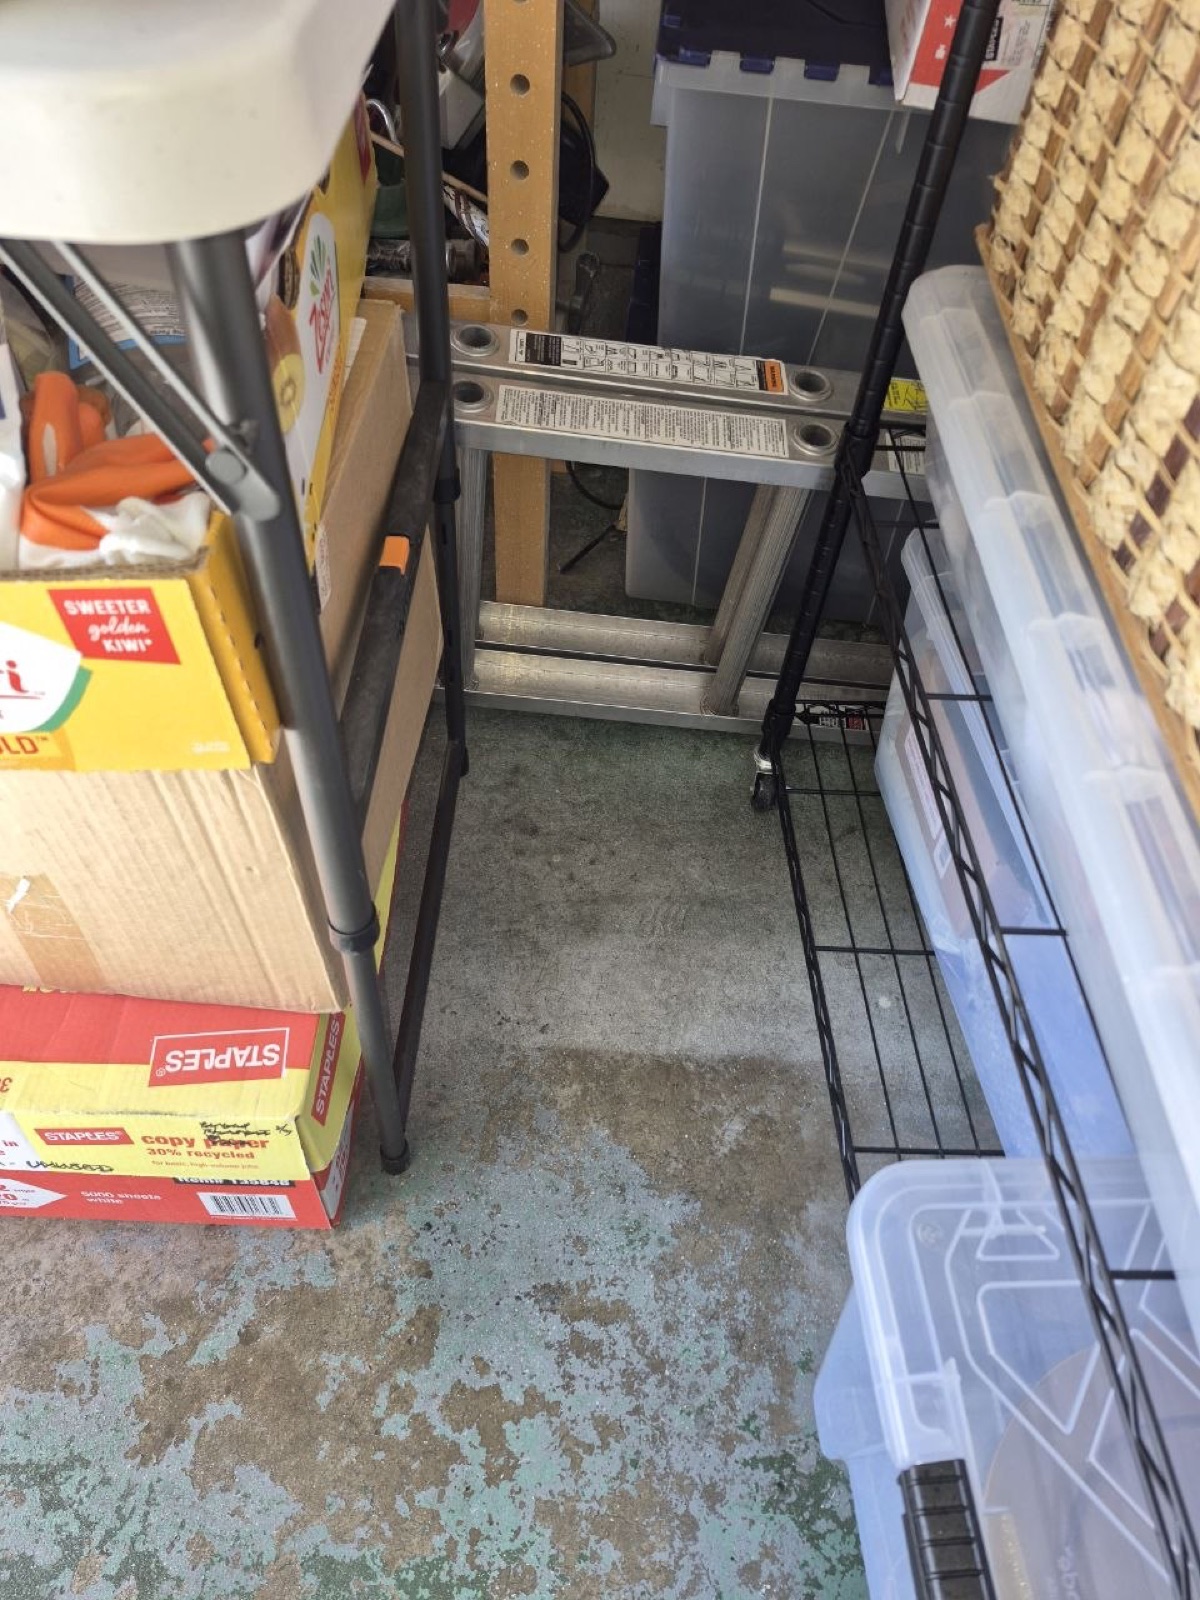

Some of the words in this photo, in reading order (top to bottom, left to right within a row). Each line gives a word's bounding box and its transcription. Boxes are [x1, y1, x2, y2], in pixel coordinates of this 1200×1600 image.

[64, 599, 152, 615] SWEETER
[88, 615, 150, 641] golden
[315, 1018, 341, 1116] STAPLES
[141, 1135, 196, 1148] copy
[203, 1137, 270, 1150] paper
[146, 1148, 182, 1157] 30%
[186, 1150, 256, 1160] recycled
